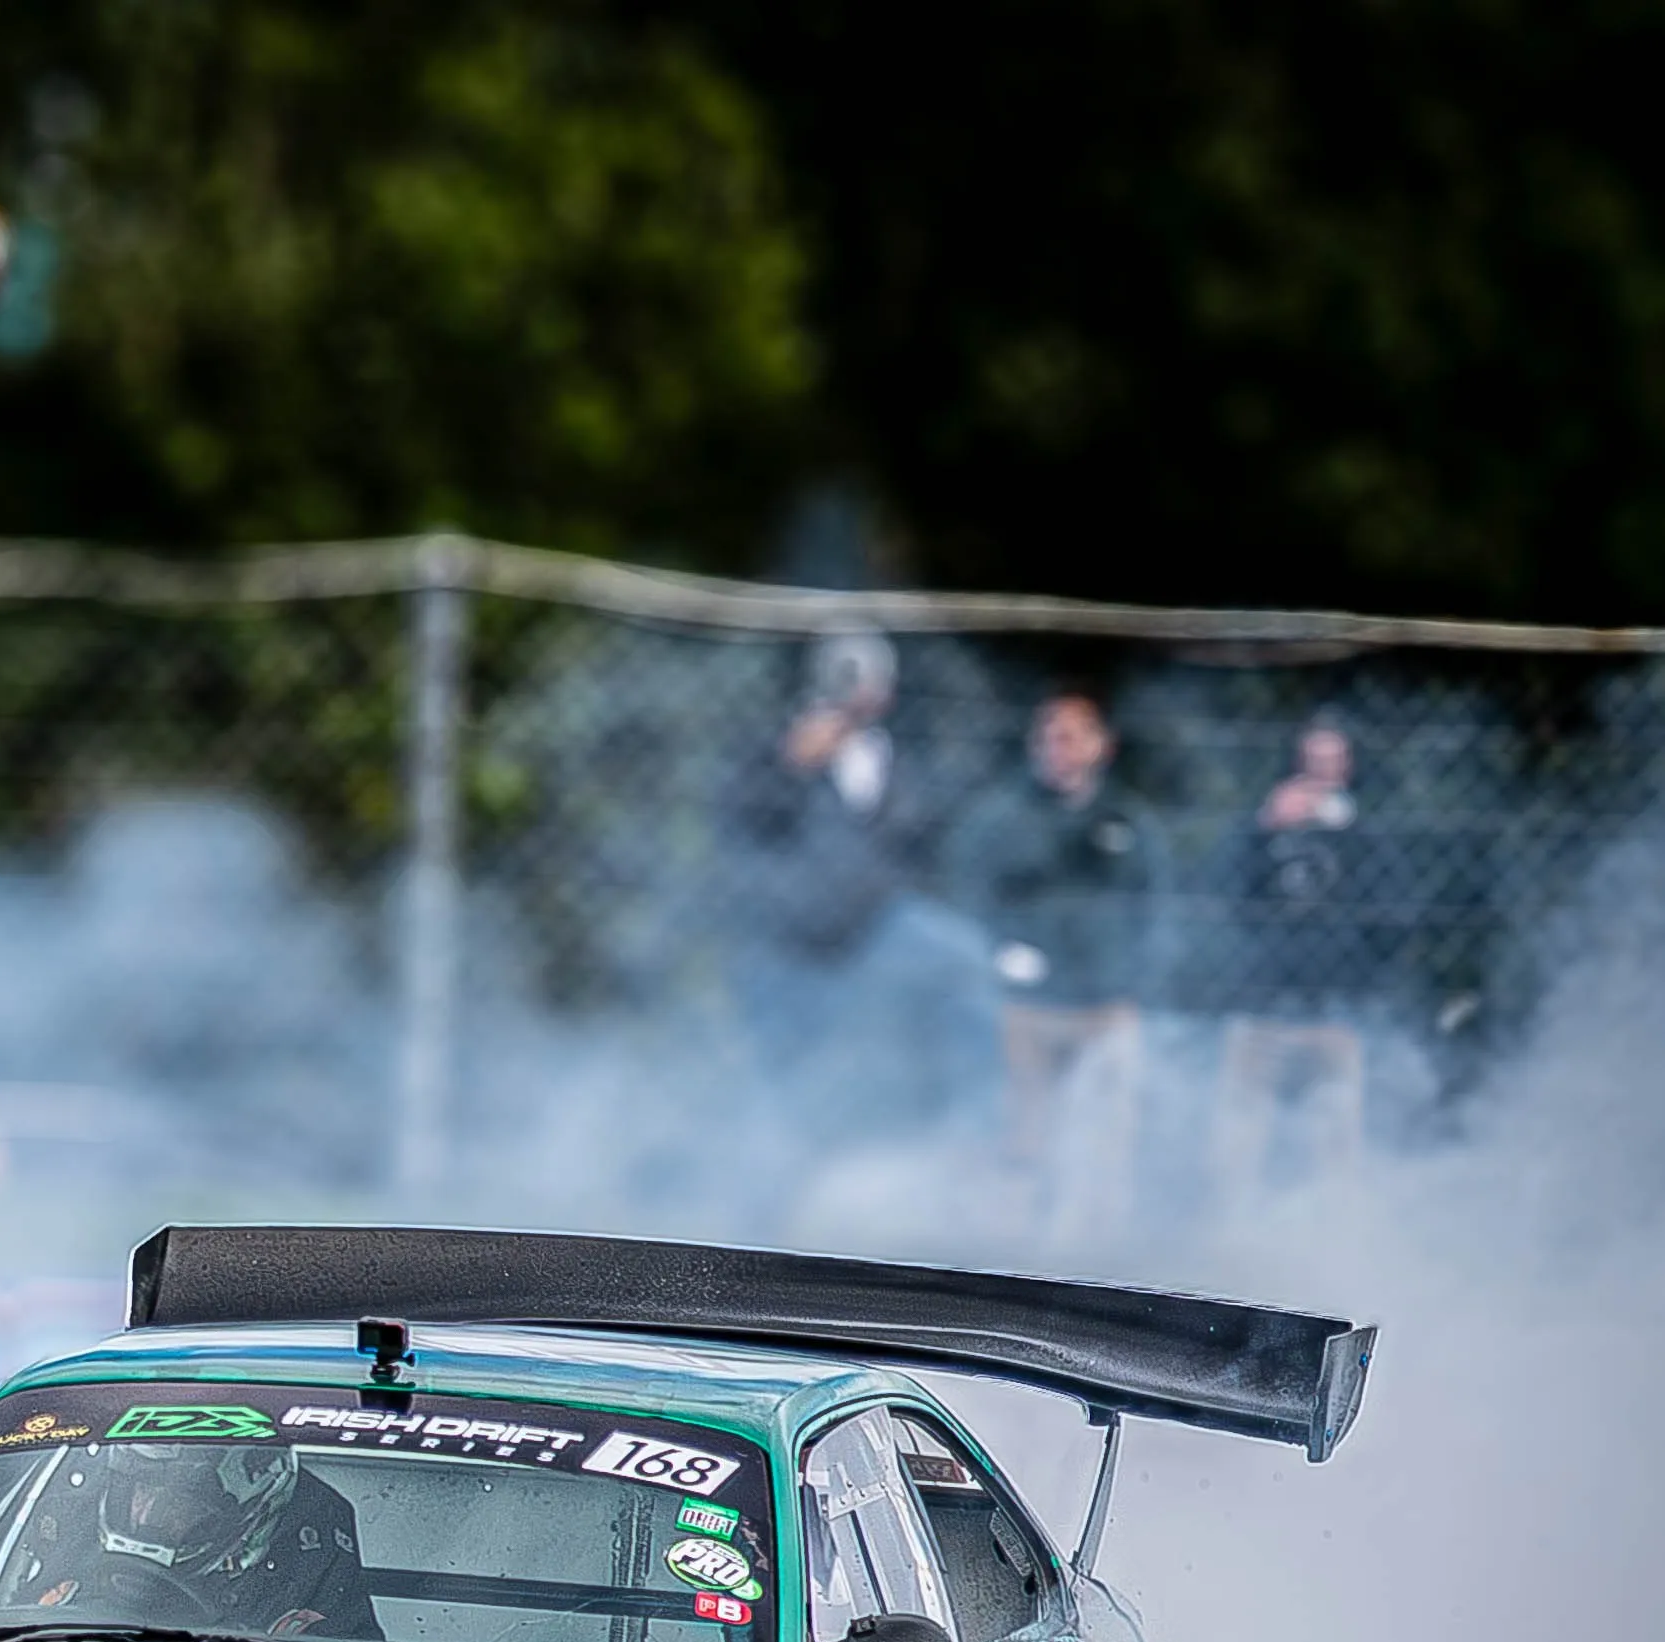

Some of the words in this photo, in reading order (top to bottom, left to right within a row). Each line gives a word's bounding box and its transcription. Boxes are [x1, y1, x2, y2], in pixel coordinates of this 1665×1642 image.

[279, 1406, 426, 1434] IRISH
[422, 1416, 587, 1449] DRIFT
[338, 1430, 558, 1462] SERIES
[611, 1438, 713, 1486] 168
[682, 1508, 735, 1535] DRIFT
[669, 1541, 745, 1587] PRO
